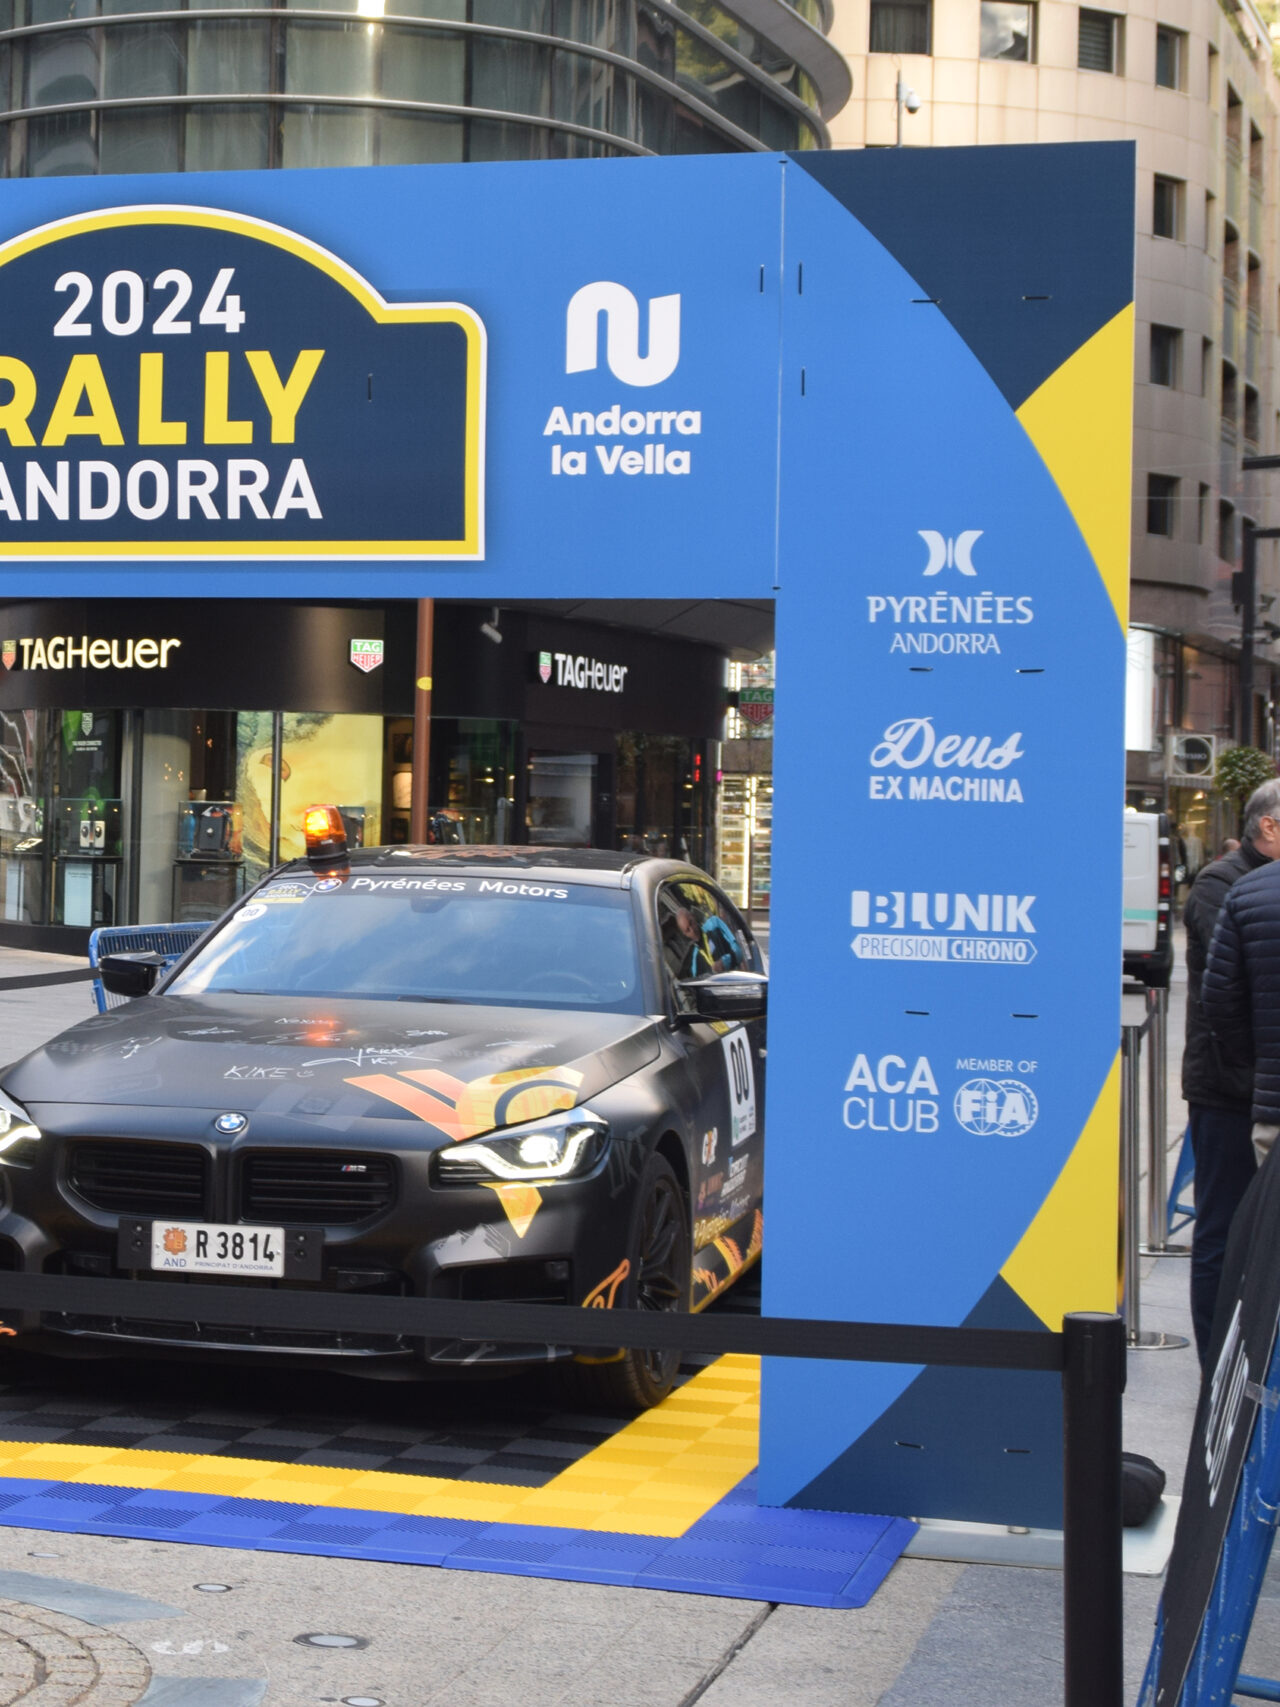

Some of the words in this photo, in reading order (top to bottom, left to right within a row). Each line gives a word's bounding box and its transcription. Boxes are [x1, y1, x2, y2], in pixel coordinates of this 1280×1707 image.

[53, 267, 246, 337] 2024
[543, 404, 702, 436] Andorra
[551, 444, 587, 476] la
[595, 443, 691, 476] Vella
[889, 632, 1001, 654] ANDORRA
[870, 716, 1024, 770] Deus
[869, 775, 903, 800] EX
[908, 775, 1024, 803] MACHINA
[351, 877, 467, 892] Pyrénées
[478, 880, 569, 899] Motors
[850, 890, 1037, 933] BLUNIK
[860, 937, 942, 957] PRECISION
[951, 940, 1027, 961] CHRONO
[730, 1037, 749, 1105] 00
[844, 1053, 940, 1096] ACA
[955, 1057, 1014, 1073] MEMBER
[1017, 1060, 1038, 1073] OF
[843, 1096, 940, 1134] CLUB
[195, 1230, 209, 1258] R
[216, 1231, 275, 1262] 3814
[163, 1258, 187, 1268] AND
[194, 1261, 231, 1269] PRINCIPAT
